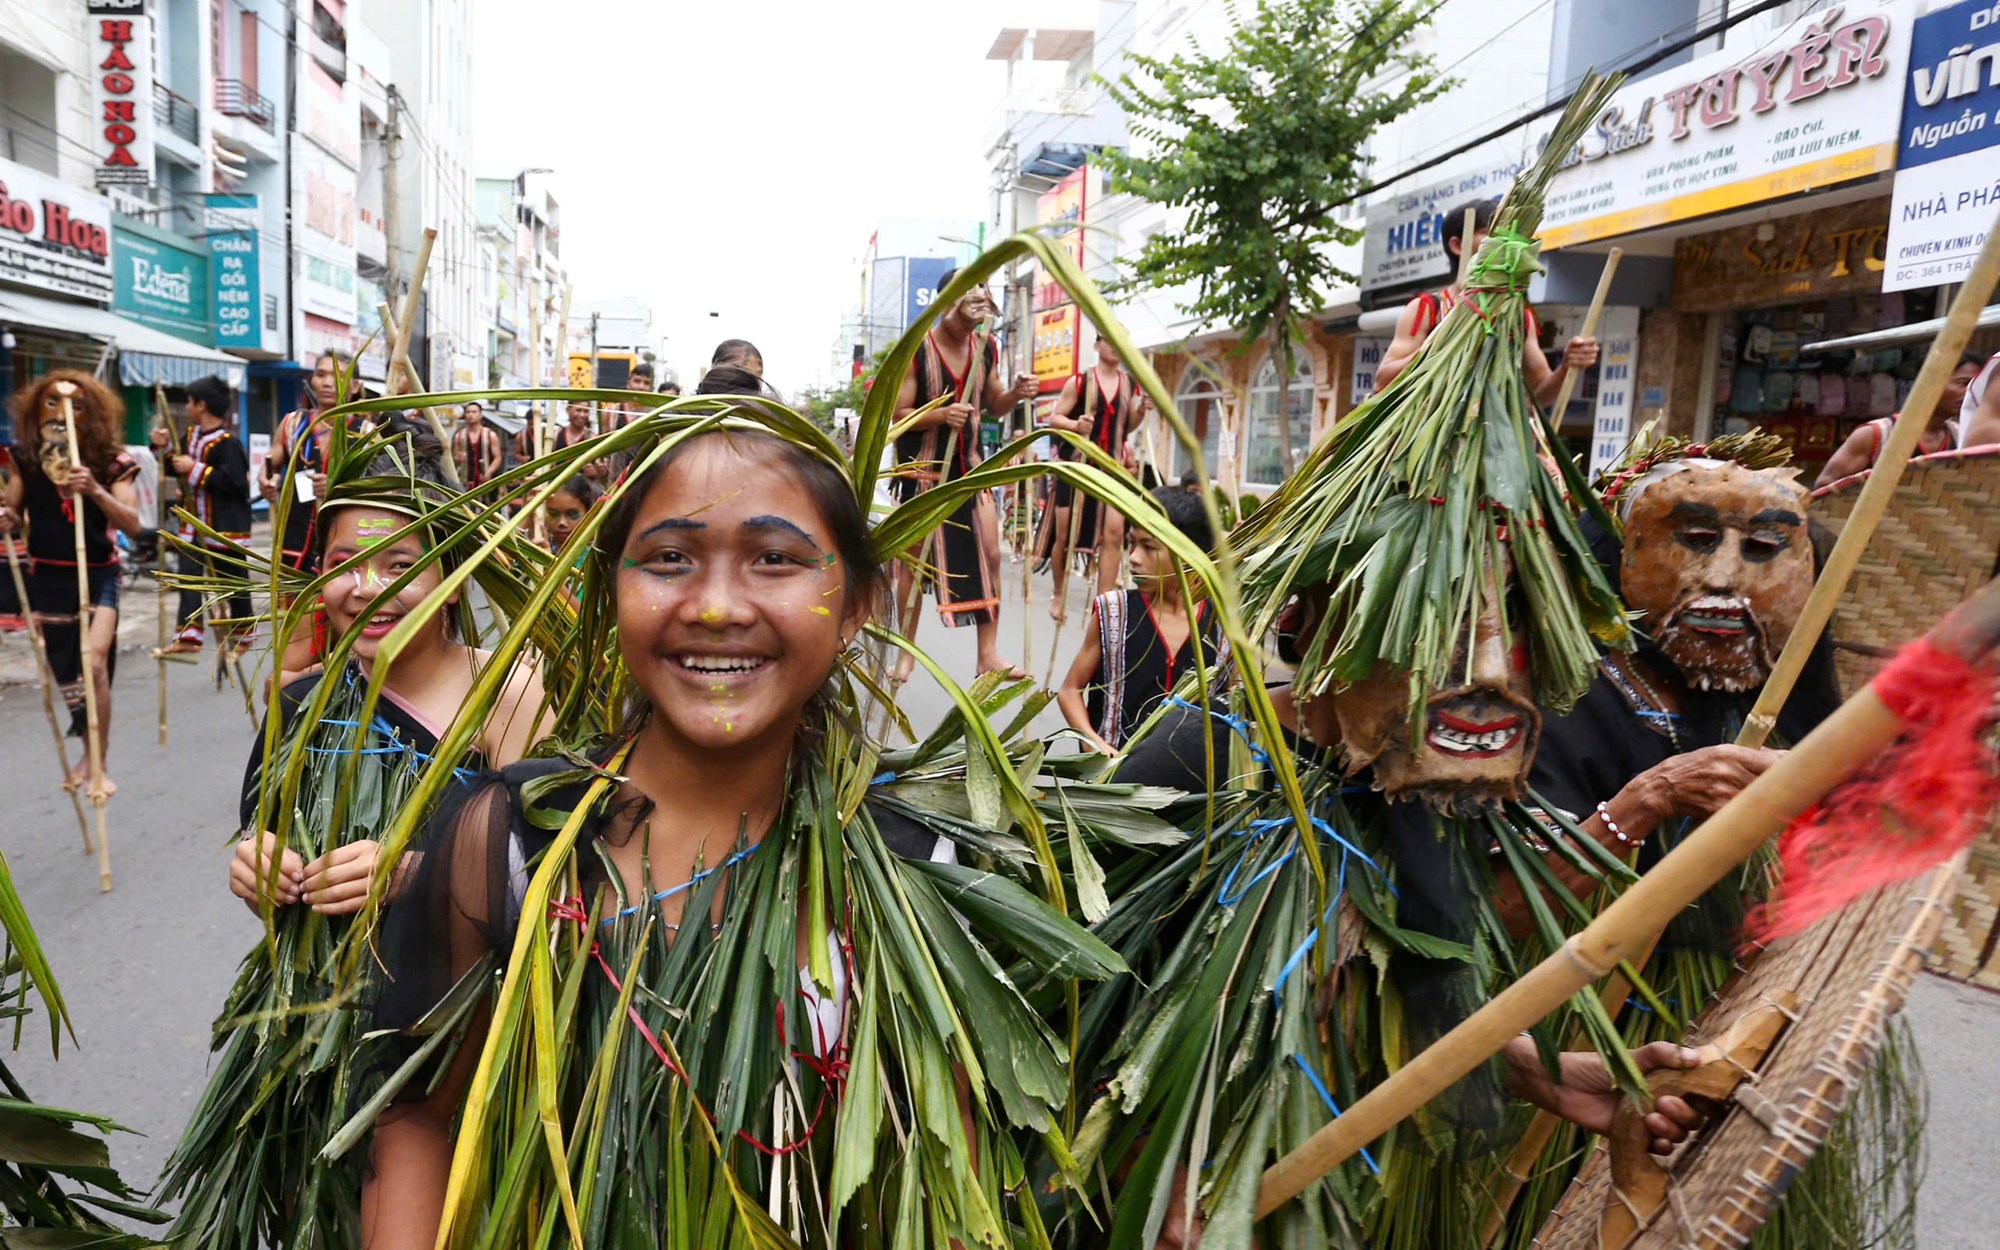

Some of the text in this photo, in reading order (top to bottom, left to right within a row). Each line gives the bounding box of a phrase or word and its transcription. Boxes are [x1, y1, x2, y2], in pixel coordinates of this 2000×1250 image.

[103, 101, 139, 167] HOA
[1902, 192, 1947, 223] NHÀ
[42, 199, 108, 257] Hoa
[1944, 234, 1974, 252] KINH
[223, 257, 243, 269] RA
[131, 256, 190, 304] Edena
[219, 307, 249, 319] CAO
[1605, 365, 1628, 380] MUA
[1598, 419, 1624, 433] TRAO
